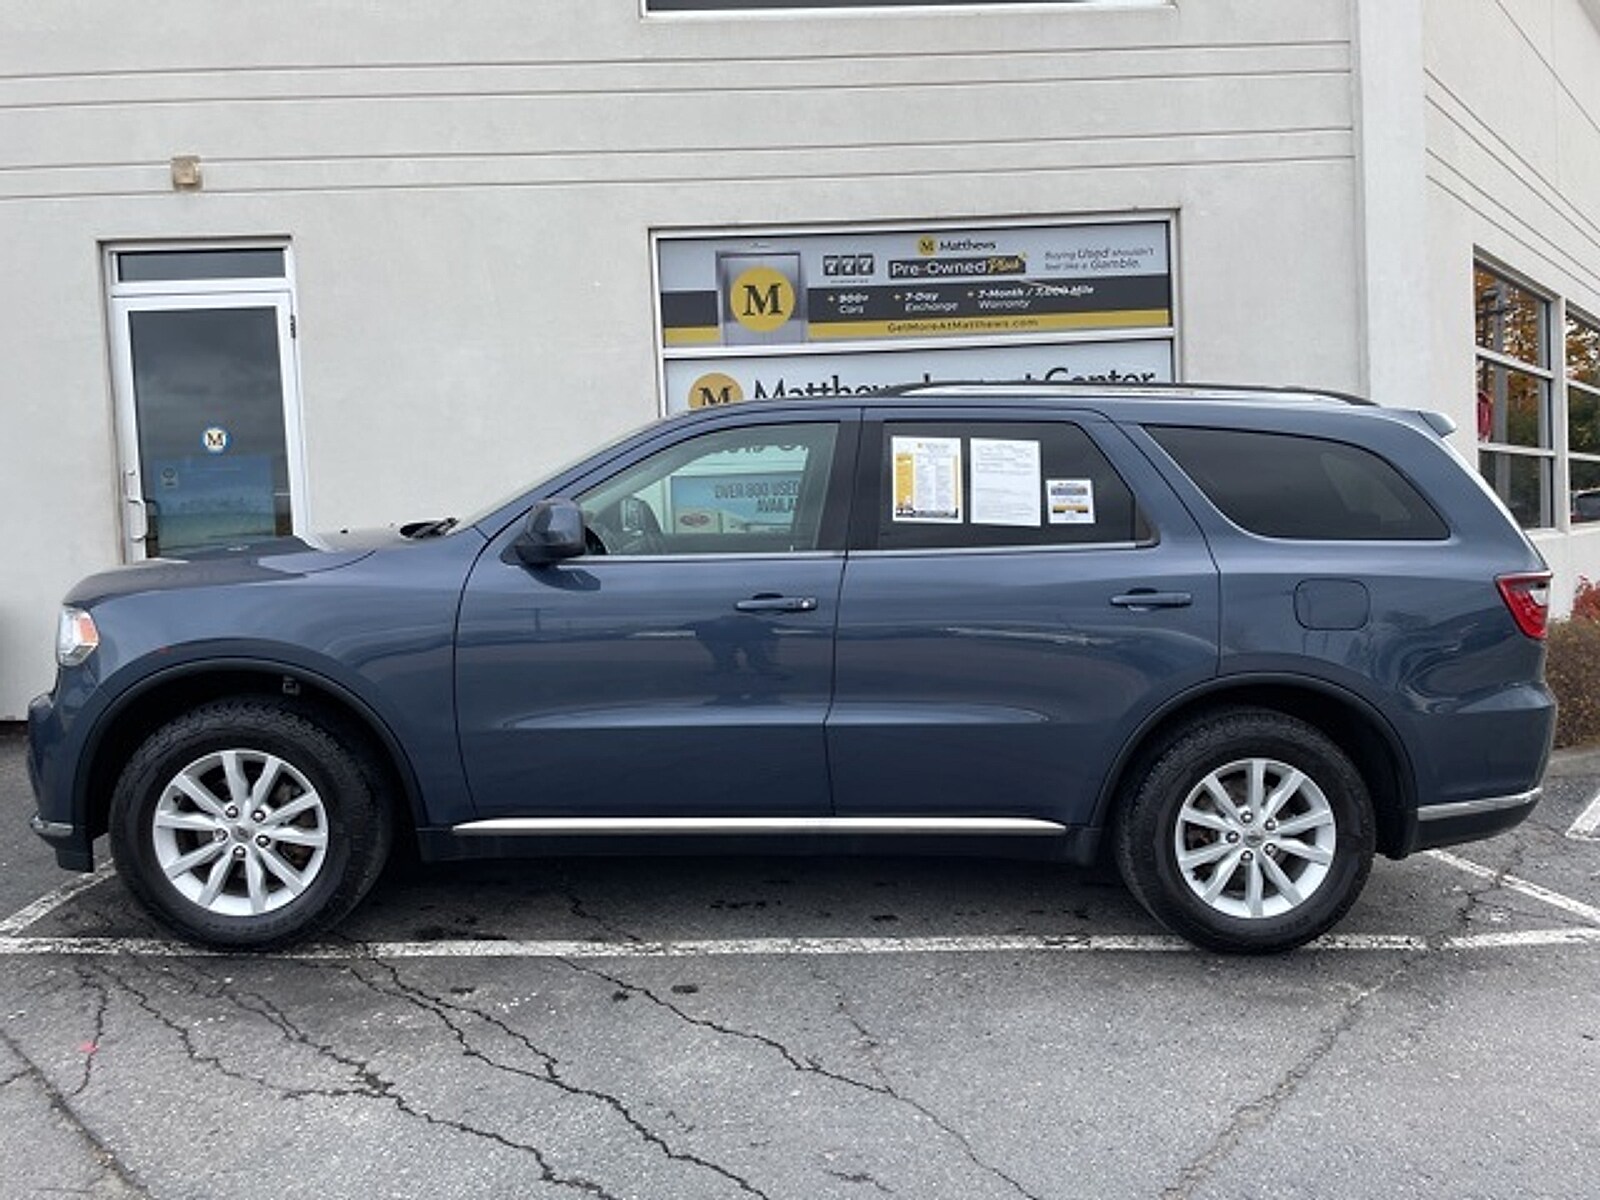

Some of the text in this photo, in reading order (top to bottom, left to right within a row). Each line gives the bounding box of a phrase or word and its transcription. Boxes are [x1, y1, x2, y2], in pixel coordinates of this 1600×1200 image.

[939, 239, 996, 250] Matthews
[891, 259, 986, 277] Pre-Owned
[742, 282, 784, 317] M
[904, 291, 939, 302] 7-Day
[904, 302, 959, 313] Exchange
[978, 299, 1031, 310] Warranty
[698, 386, 733, 406] M
[755, 375, 892, 399] Matthe
[206, 432, 224, 447] M
